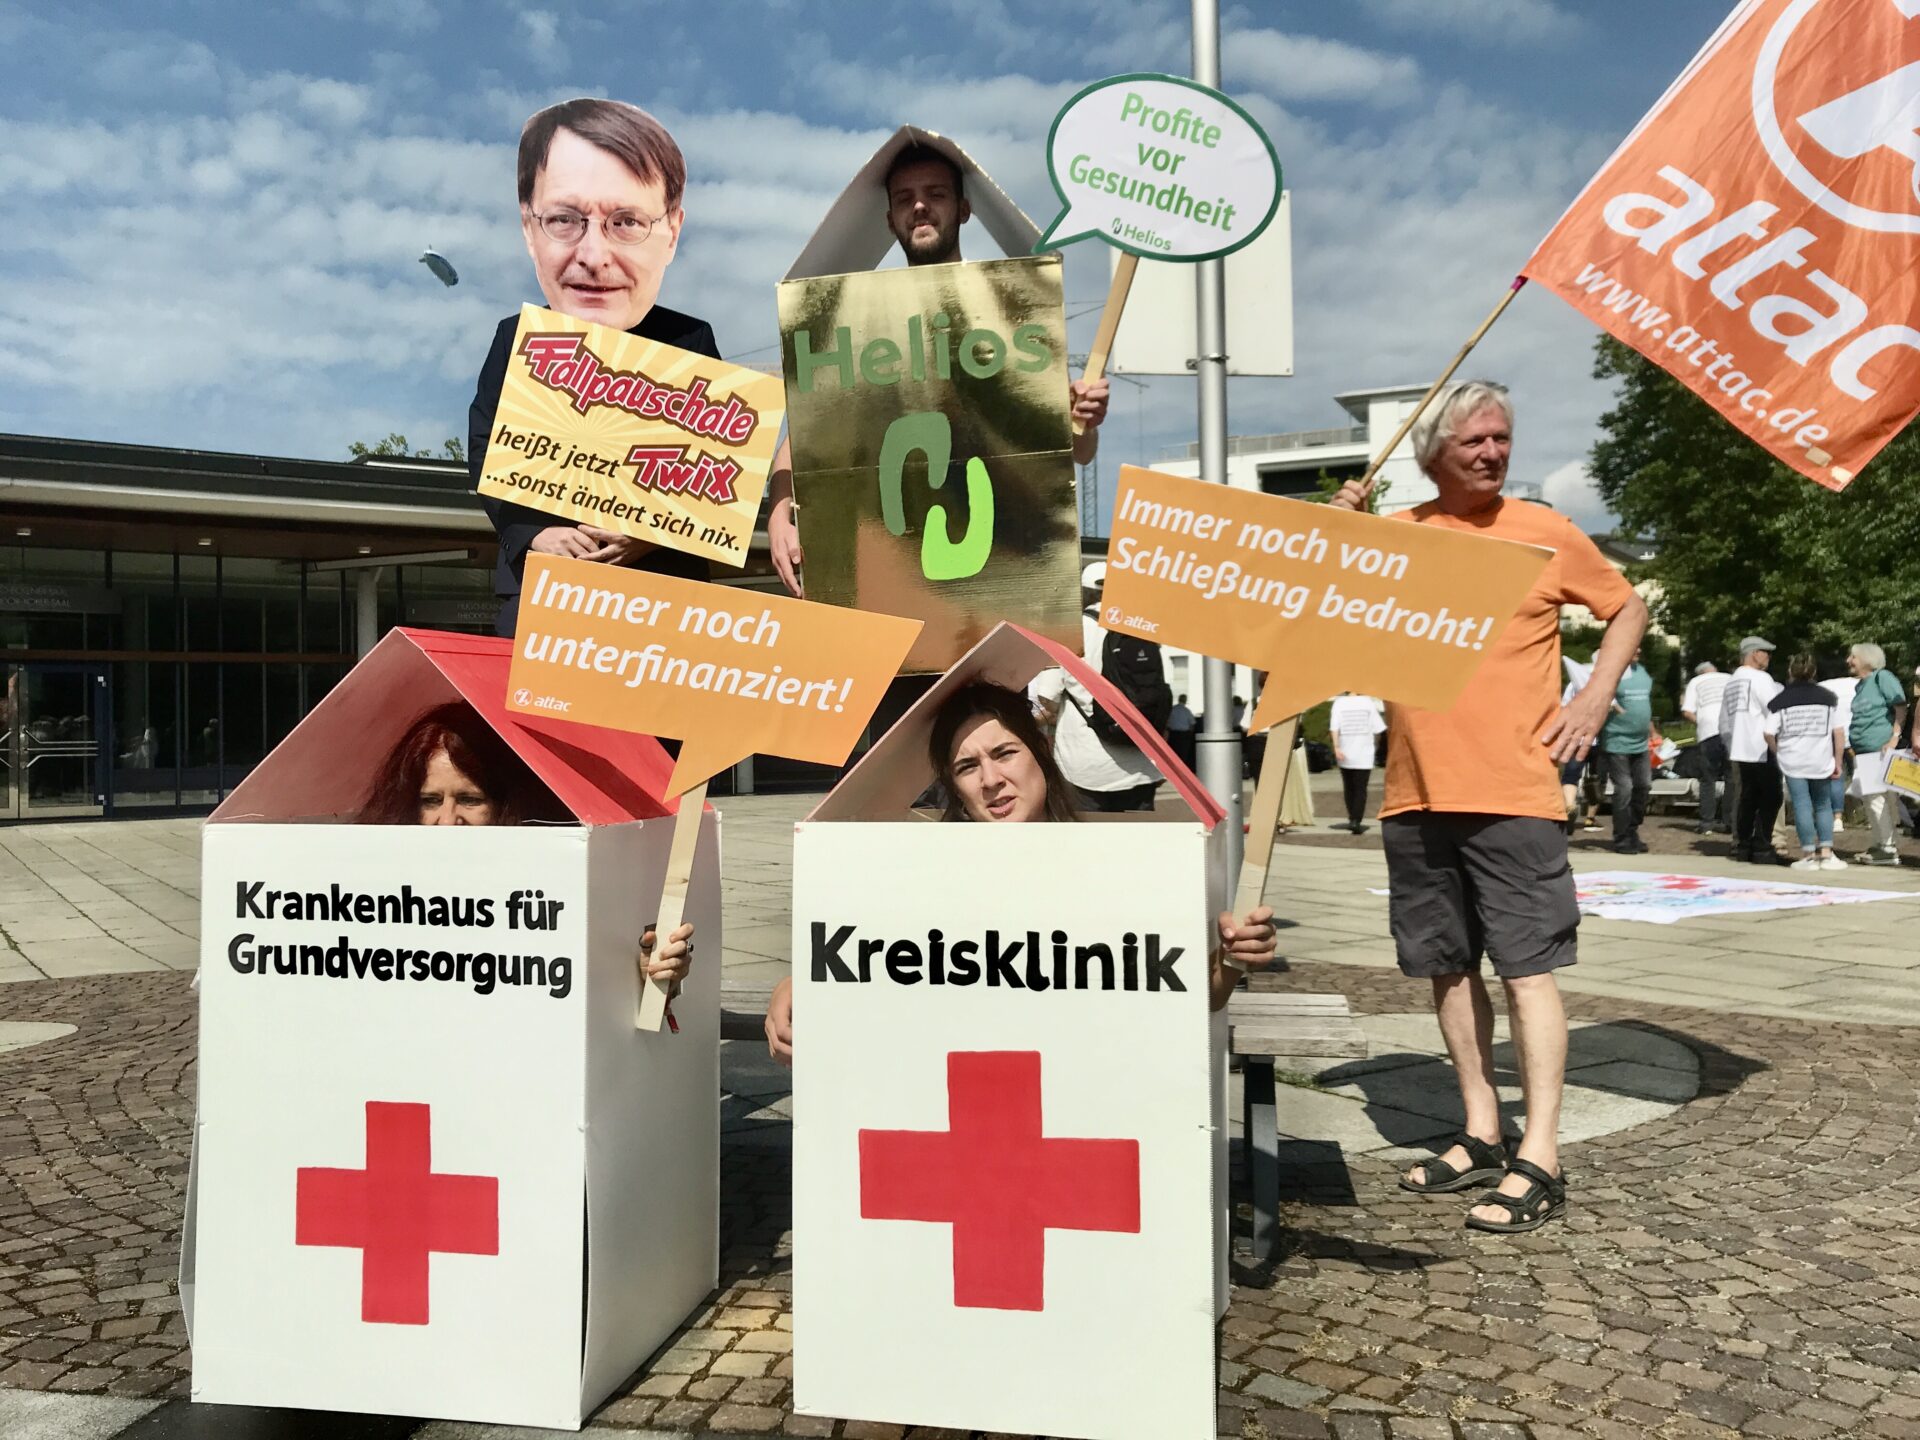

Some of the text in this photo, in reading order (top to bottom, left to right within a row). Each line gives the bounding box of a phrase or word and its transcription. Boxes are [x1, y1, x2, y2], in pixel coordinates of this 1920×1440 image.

[1120, 92, 1222, 149] Profite
[1137, 142, 1186, 175] vor
[1069, 154, 1236, 232] Gesundheit
[1123, 223, 1171, 251] Helios
[1603, 165, 1920, 402] attac
[520, 334, 757, 444] Fallpauschale
[794, 312, 1052, 393] Helios
[1575, 262, 1829, 447] www.attac.de
[495, 425, 739, 503] heißt jetzt Twix
[571, 485, 646, 524] ändert
[650, 512, 695, 538] sich
[700, 526, 741, 551] nix.
[1118, 488, 1409, 581] Immer noch von
[530, 569, 781, 648] Immer noch
[1110, 537, 1494, 651] Schließung bedroht!
[1124, 614, 1160, 634] attac
[523, 632, 854, 713] unterfinanziert!
[533, 695, 572, 713] attac
[236, 881, 564, 931] Krankenhaus für
[228, 933, 572, 999] Grundversorgung
[811, 921, 1188, 992] Kreisklinik
